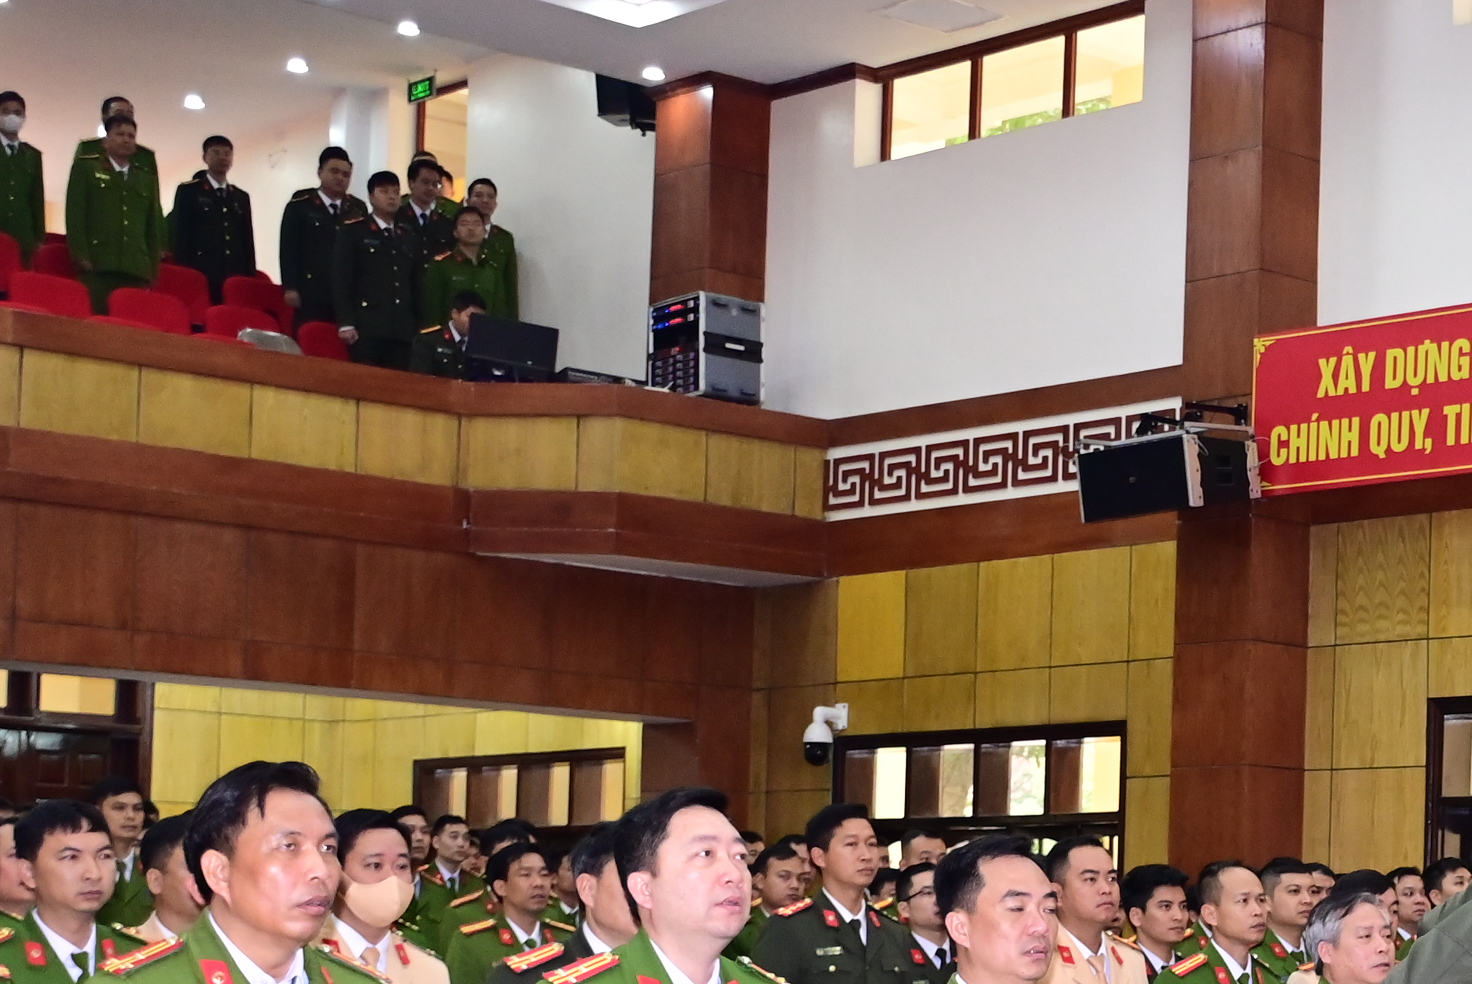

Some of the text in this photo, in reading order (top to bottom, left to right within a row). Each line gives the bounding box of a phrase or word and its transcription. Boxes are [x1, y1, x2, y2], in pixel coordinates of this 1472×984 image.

[1318, 348, 1376, 398] XÂY
[1385, 338, 1471, 389] DỰNG
[1270, 413, 1360, 465] CHÍNH
[1370, 408, 1432, 457] QUY,
